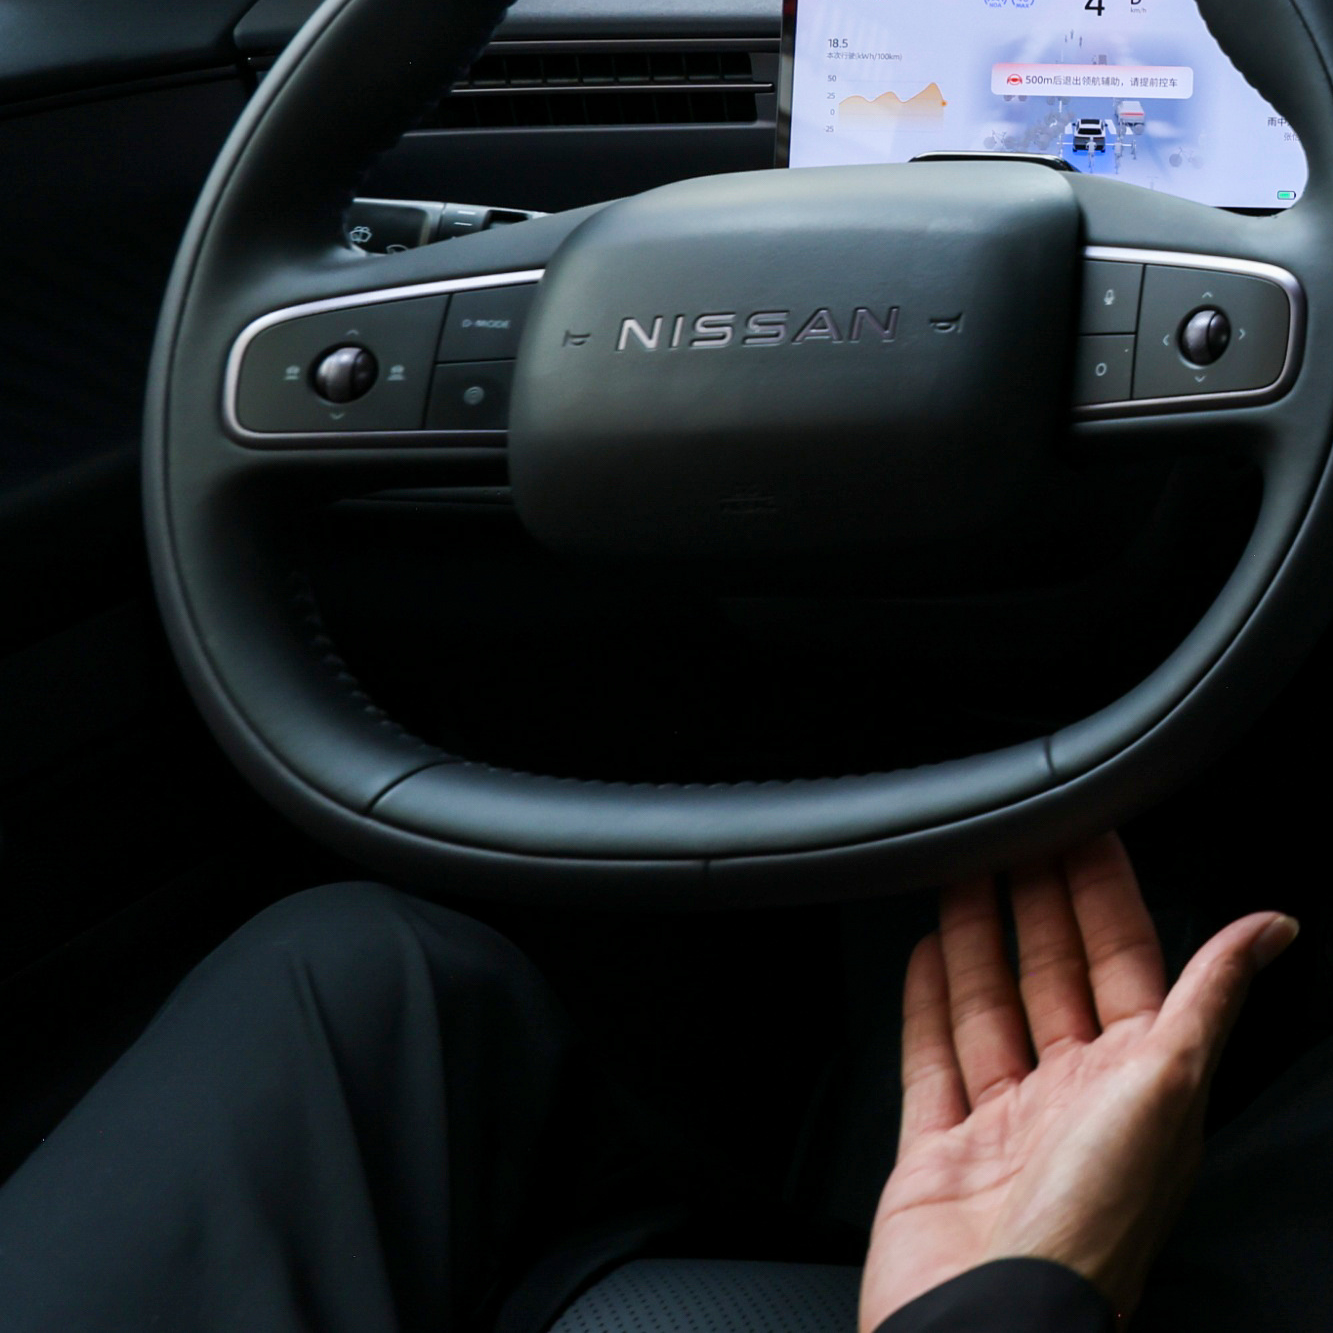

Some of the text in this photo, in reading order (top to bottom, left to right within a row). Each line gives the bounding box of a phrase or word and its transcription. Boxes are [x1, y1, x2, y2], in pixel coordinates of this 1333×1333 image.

[827, 38, 849, 49] 18.5
[827, 74, 837, 82] 50
[826, 92, 836, 100] 25
[830, 108, 835, 116] 0
[614, 305, 901, 352] NISSAN
